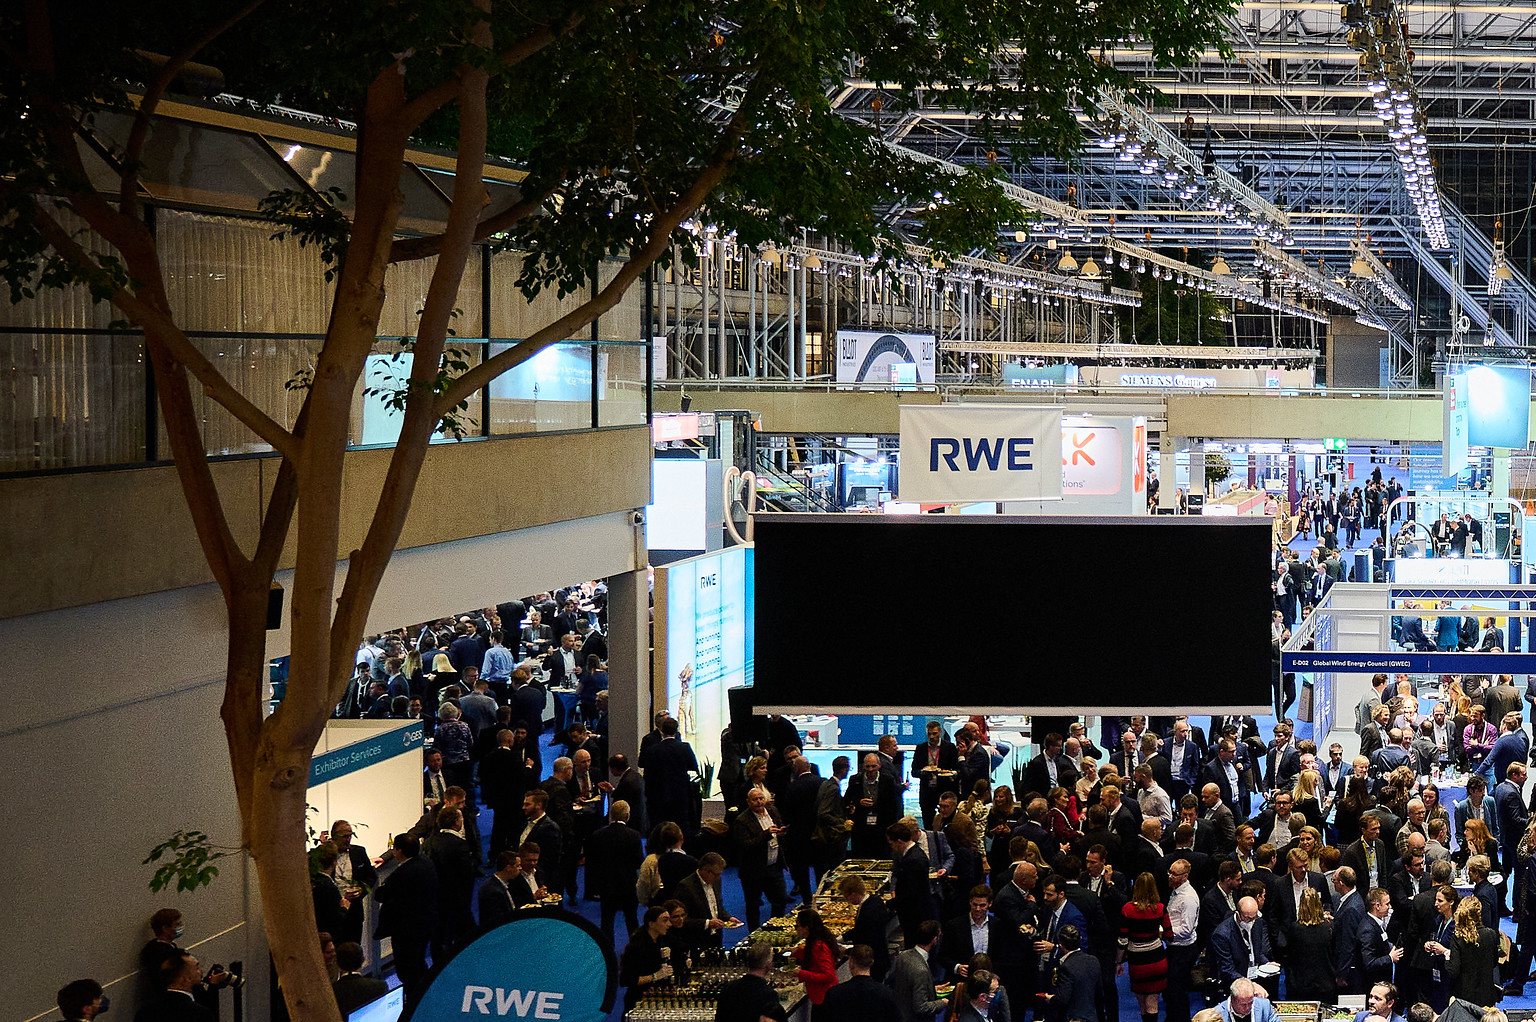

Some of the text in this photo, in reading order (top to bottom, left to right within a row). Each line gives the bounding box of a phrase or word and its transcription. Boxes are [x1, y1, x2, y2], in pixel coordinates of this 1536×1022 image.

[1120, 374, 1172, 386] SIEMENS
[930, 438, 1034, 472] RWE
[700, 573, 717, 589] RWE
[315, 744, 382, 776] Exhibitor Services
[461, 985, 565, 1020] RWE
